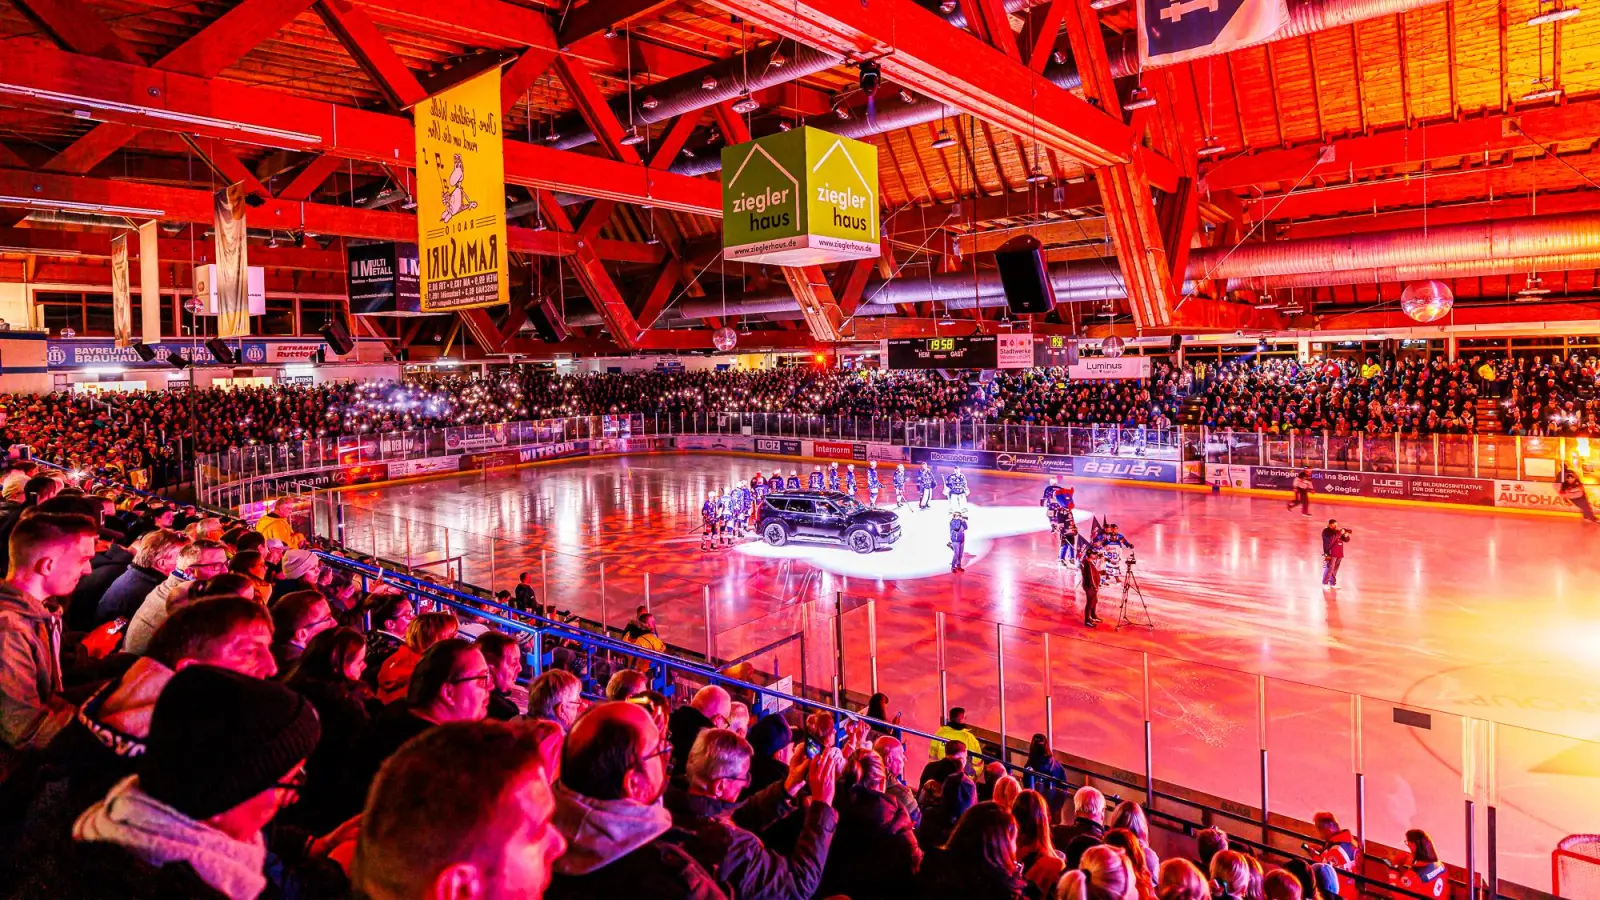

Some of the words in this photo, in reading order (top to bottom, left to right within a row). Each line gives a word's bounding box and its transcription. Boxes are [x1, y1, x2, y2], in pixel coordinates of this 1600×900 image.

[733, 187, 789, 213] ziegler
[817, 183, 865, 210] ziegler
[750, 212, 790, 232] haus
[834, 207, 867, 231] haus
[734, 239, 796, 255] www.zieglerhaus.de
[819, 239, 872, 252] www.zieglerhaus.de
[75, 347, 137, 355] BAYREUTHE
[1086, 362, 1122, 370] Luminus
[759, 440, 780, 450] IGZ
[815, 445, 850, 454] Internorm
[520, 442, 575, 462] WITRON
[1270, 470, 1298, 478] bringen
[1338, 474, 1360, 482] Spiel.
[1373, 479, 1403, 487] LUCE
[1422, 482, 1483, 491] BILDUNGSINITIATIVE
[1335, 486, 1360, 494] Regler
